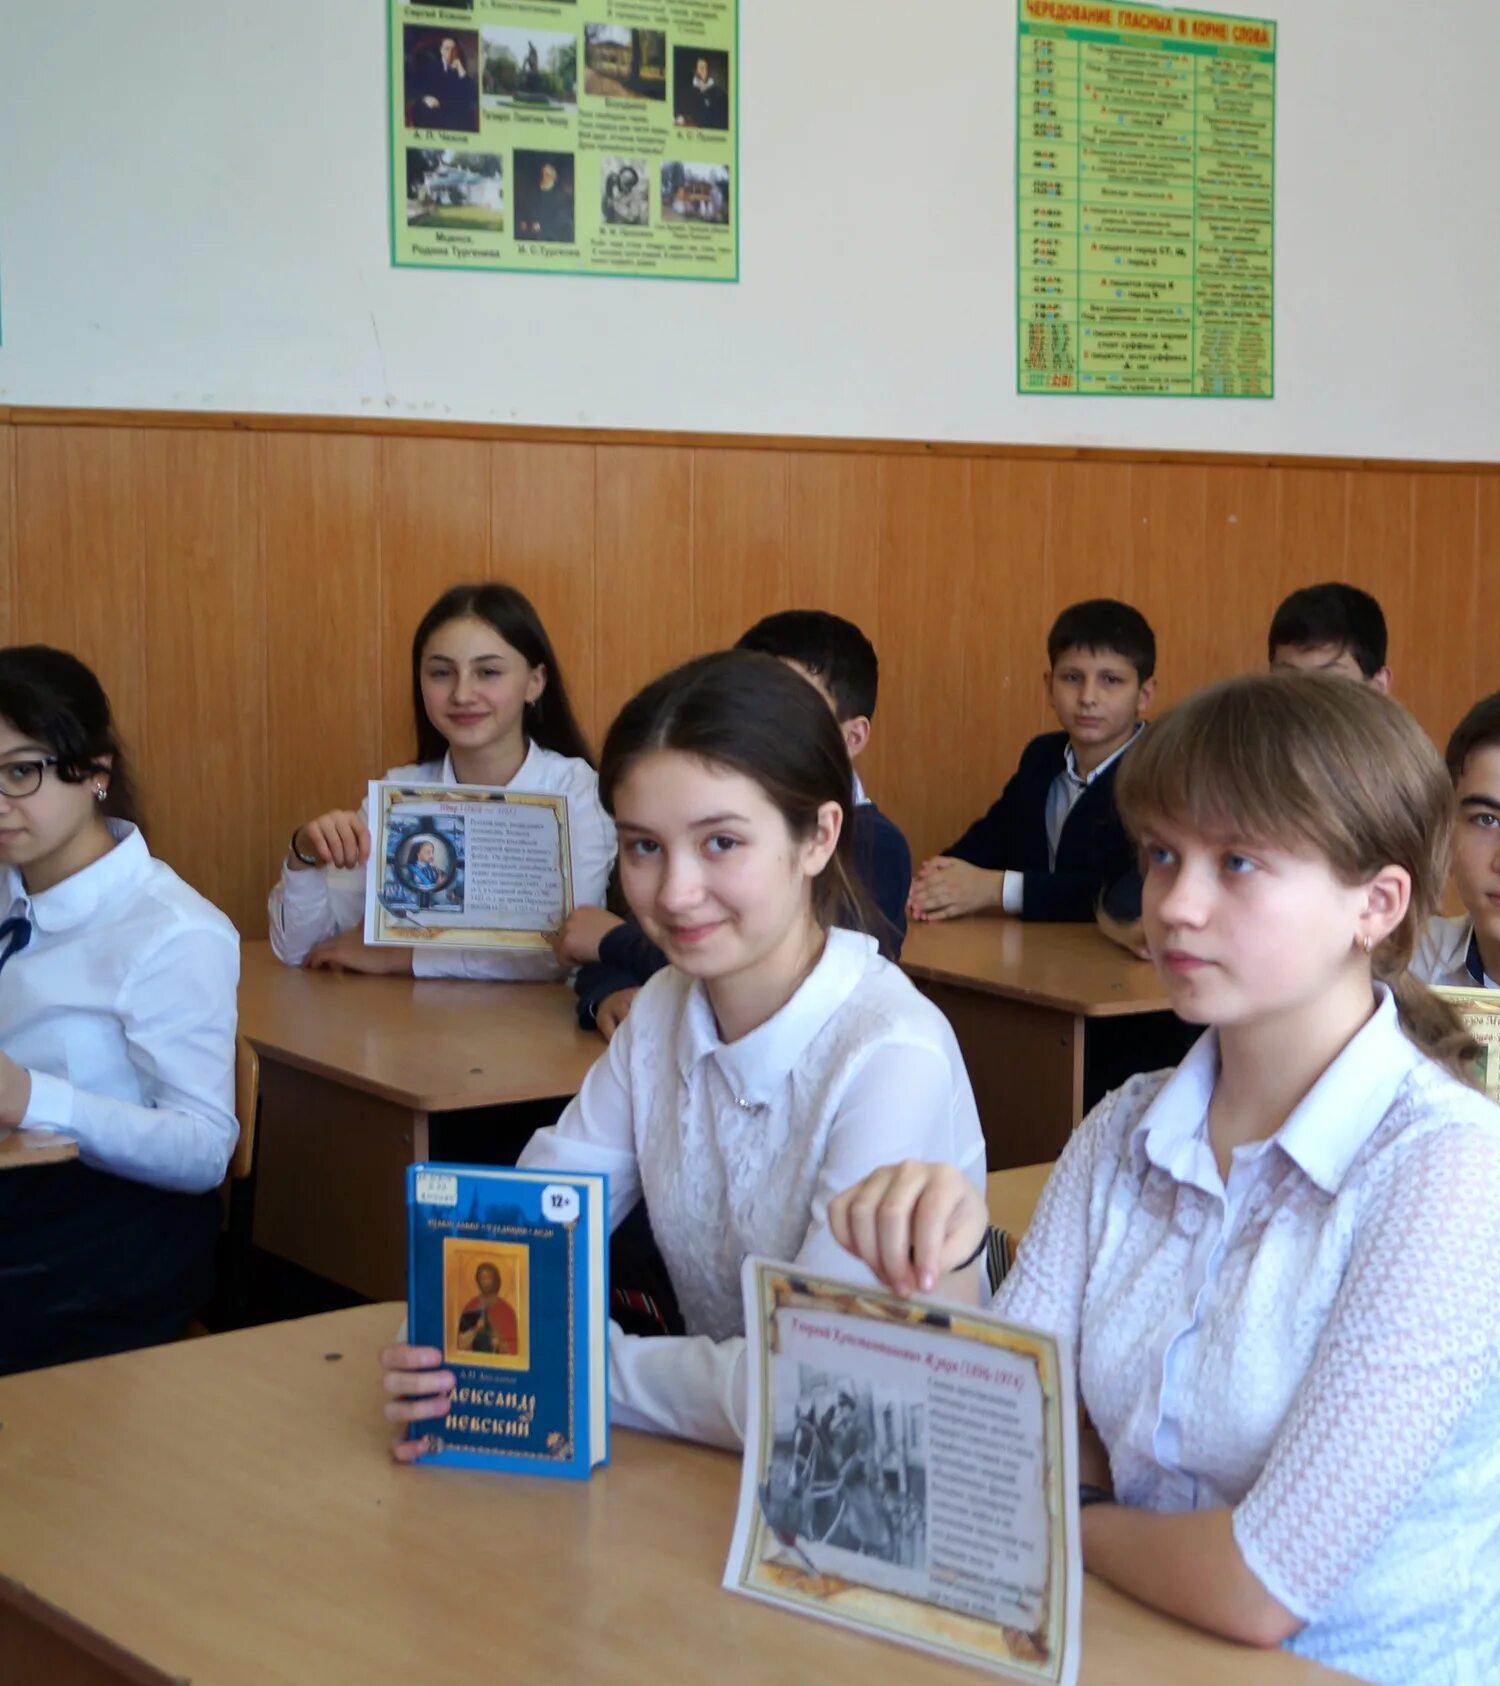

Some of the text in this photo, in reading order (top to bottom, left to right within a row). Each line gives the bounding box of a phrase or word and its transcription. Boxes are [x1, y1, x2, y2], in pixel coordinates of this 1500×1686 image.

[1027, 0, 1269, 46] ЧЕРЕДОВАНИЕ ГЛАСНЫХ В КОРНЕ СЛОВА
[550, 1193, 570, 1208] 12+
[449, 1386, 536, 1422] ЛЕКСАНДР
[445, 1413, 530, 1437] НЕВСКИЙ
